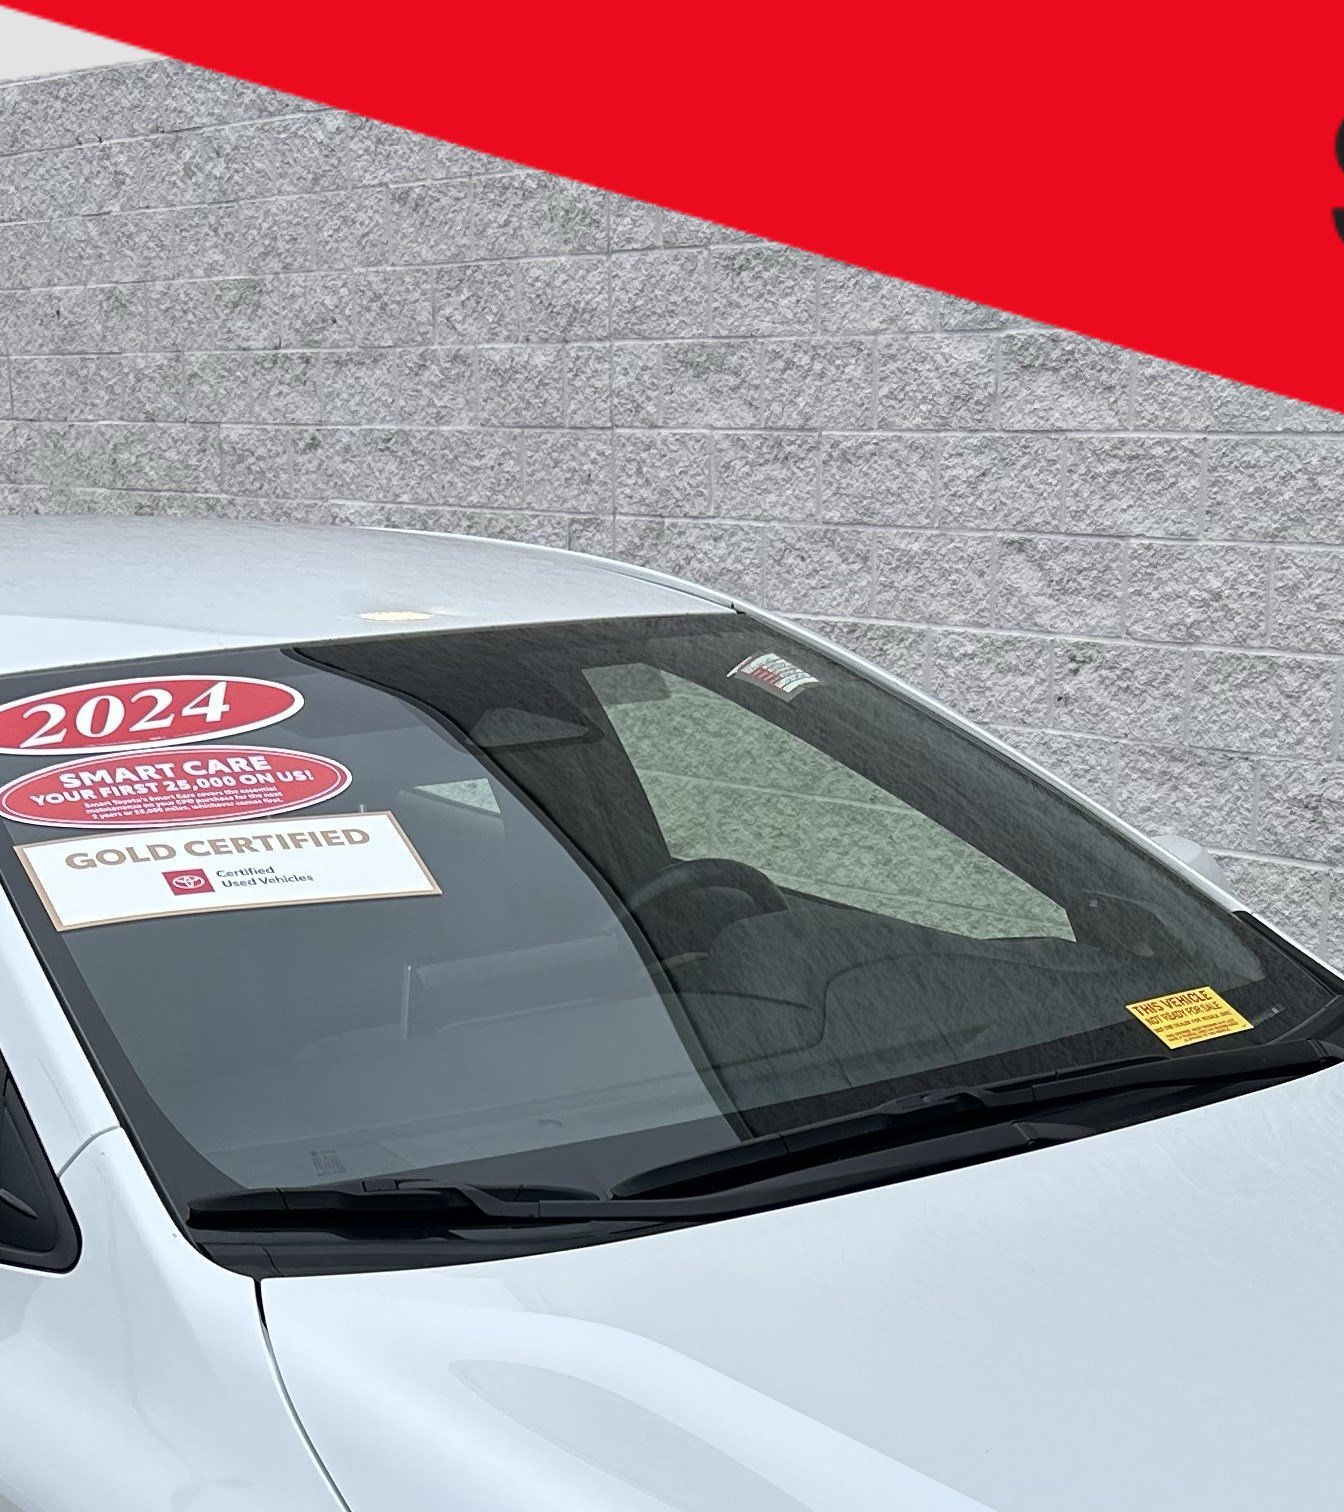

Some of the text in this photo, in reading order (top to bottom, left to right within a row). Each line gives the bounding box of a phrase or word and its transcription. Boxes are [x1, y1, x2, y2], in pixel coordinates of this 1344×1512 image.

[19, 681, 230, 749] 2024
[30, 769, 314, 806] YOUR FIRST 25,000 ON US!
[59, 755, 272, 789] SMART CARE
[65, 828, 370, 870] GOLD CERTIFIED
[216, 865, 275, 878] Certified
[222, 874, 314, 888] Used Vehicles
[1131, 990, 1213, 1016] THIS VEHICLE
